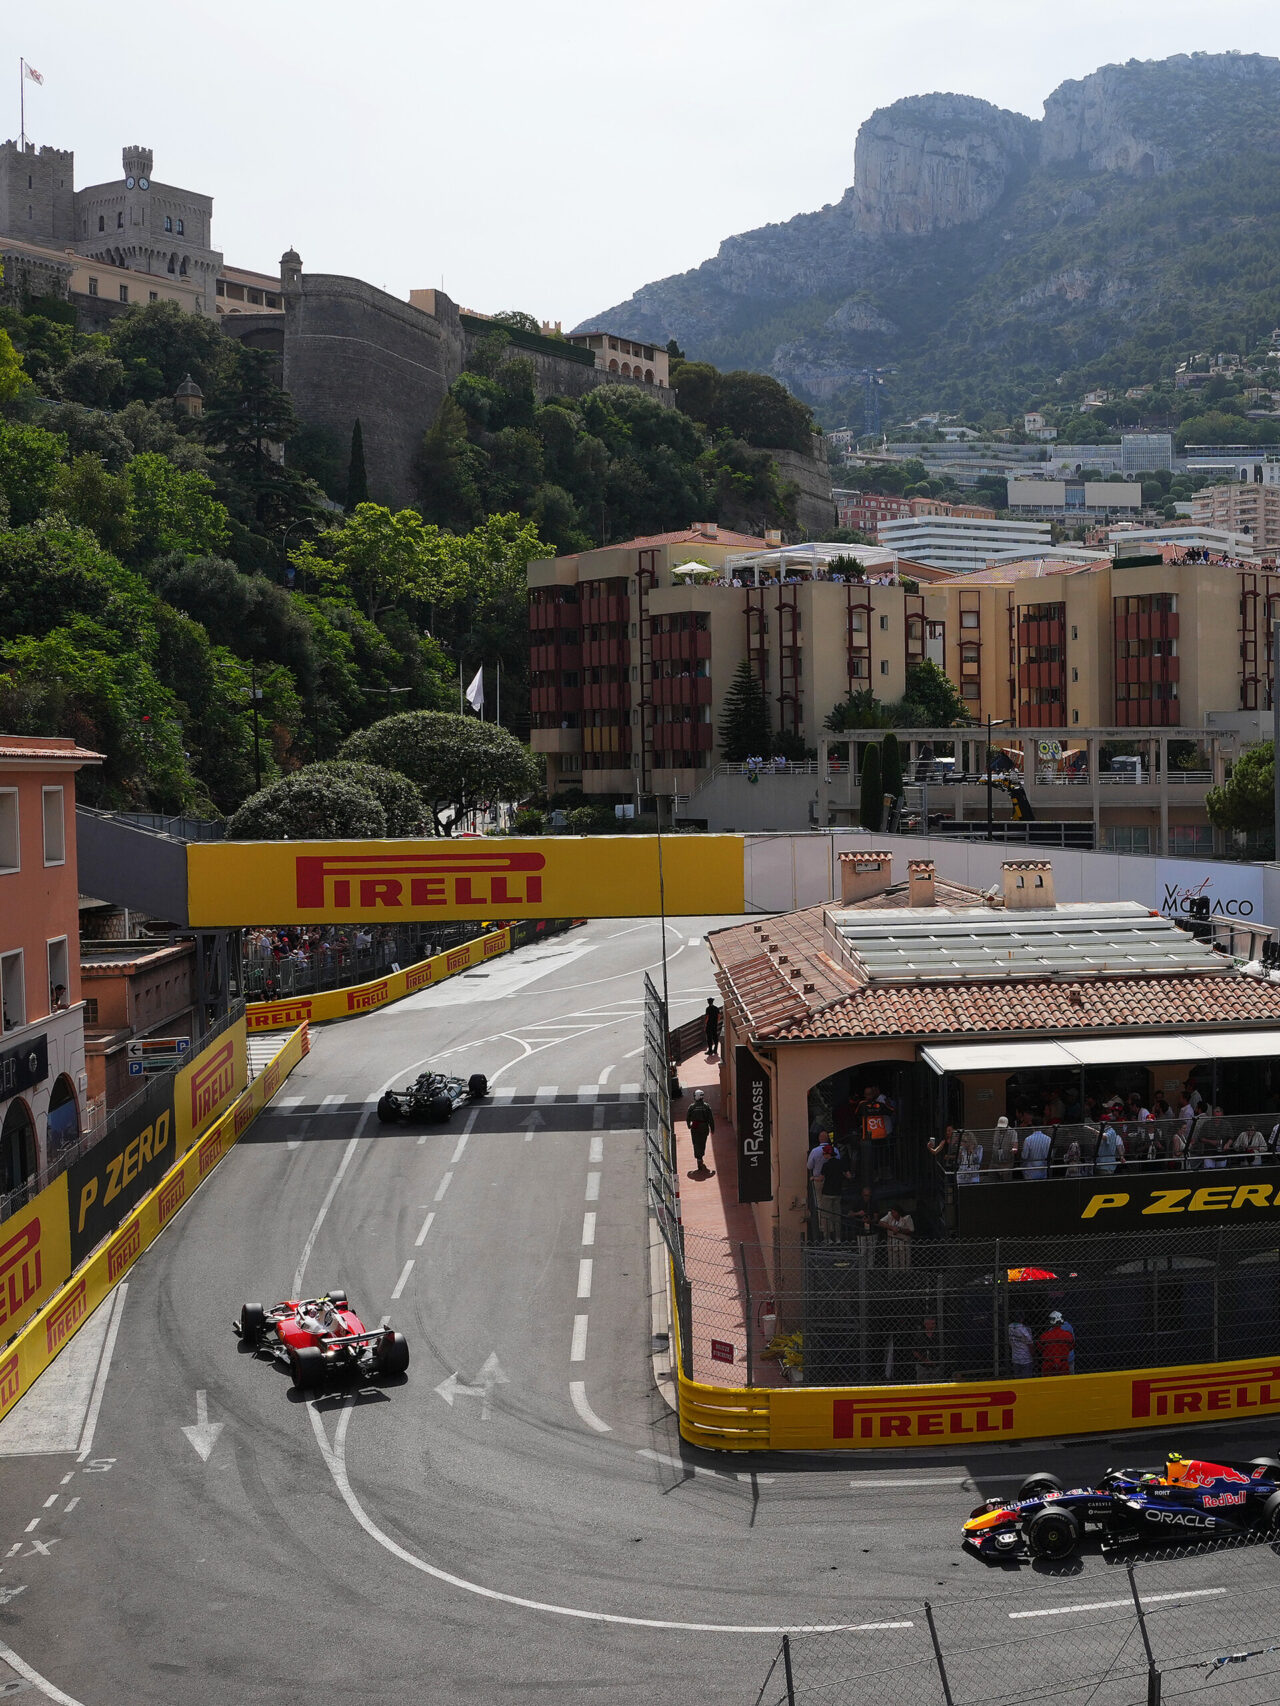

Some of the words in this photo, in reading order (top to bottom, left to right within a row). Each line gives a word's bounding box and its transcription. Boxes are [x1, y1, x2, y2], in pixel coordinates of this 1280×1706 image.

[296, 852, 546, 908] PIRELLI
[1162, 896, 1253, 916] MOACO
[447, 947, 471, 971] PIRELLI
[483, 933, 506, 955] PIRELLI
[347, 982, 388, 1011] PIRELLI
[406, 963, 432, 991] PIRELLI
[191, 1039, 234, 1129] PIRELLI
[263, 1061, 280, 1099] PIRELLI
[234, 1092, 253, 1136] PIRELLI
[744, 1081, 764, 1155] RASCASSE
[78, 1176, 98, 1234] P
[103, 1108, 170, 1207] ZERO
[199, 1127, 222, 1176] PIRELLI
[751, 1155, 758, 1167] LA
[158, 1168, 185, 1224] PIRELLI
[1081, 1193, 1130, 1218] P
[107, 1218, 141, 1284] PIRELLI
[46, 1278, 87, 1355] PIRELLI
[833, 1390, 1017, 1440] PIRELLI
[1251, 1466, 1268, 1478] 6
[1145, 1510, 1216, 1528] ORACLE
